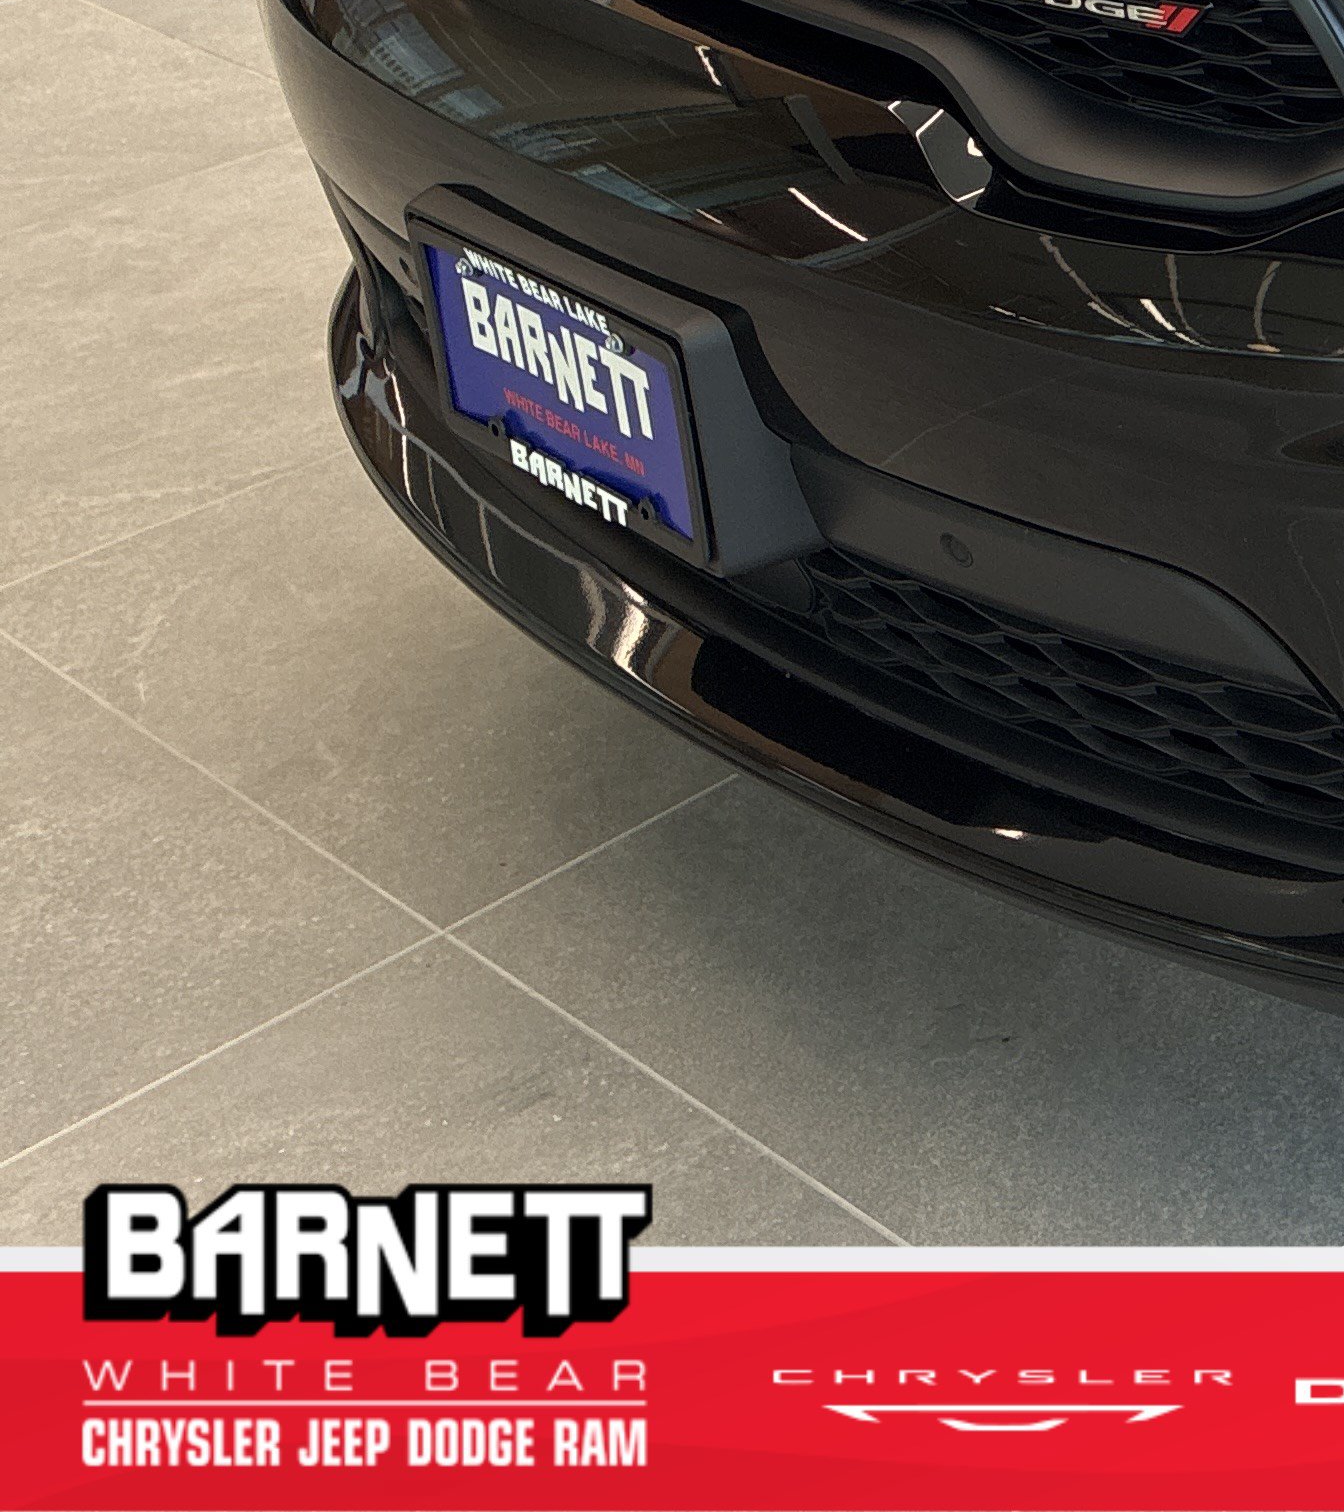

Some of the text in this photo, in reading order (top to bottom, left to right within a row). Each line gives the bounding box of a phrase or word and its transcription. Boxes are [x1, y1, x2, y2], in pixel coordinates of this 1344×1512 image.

[462, 247, 612, 338] WHITE BEAR LAKE
[460, 276, 654, 441] BARNETT
[502, 387, 545, 423] WHITE
[544, 408, 582, 443] BEAR
[509, 438, 628, 528] BARNETT
